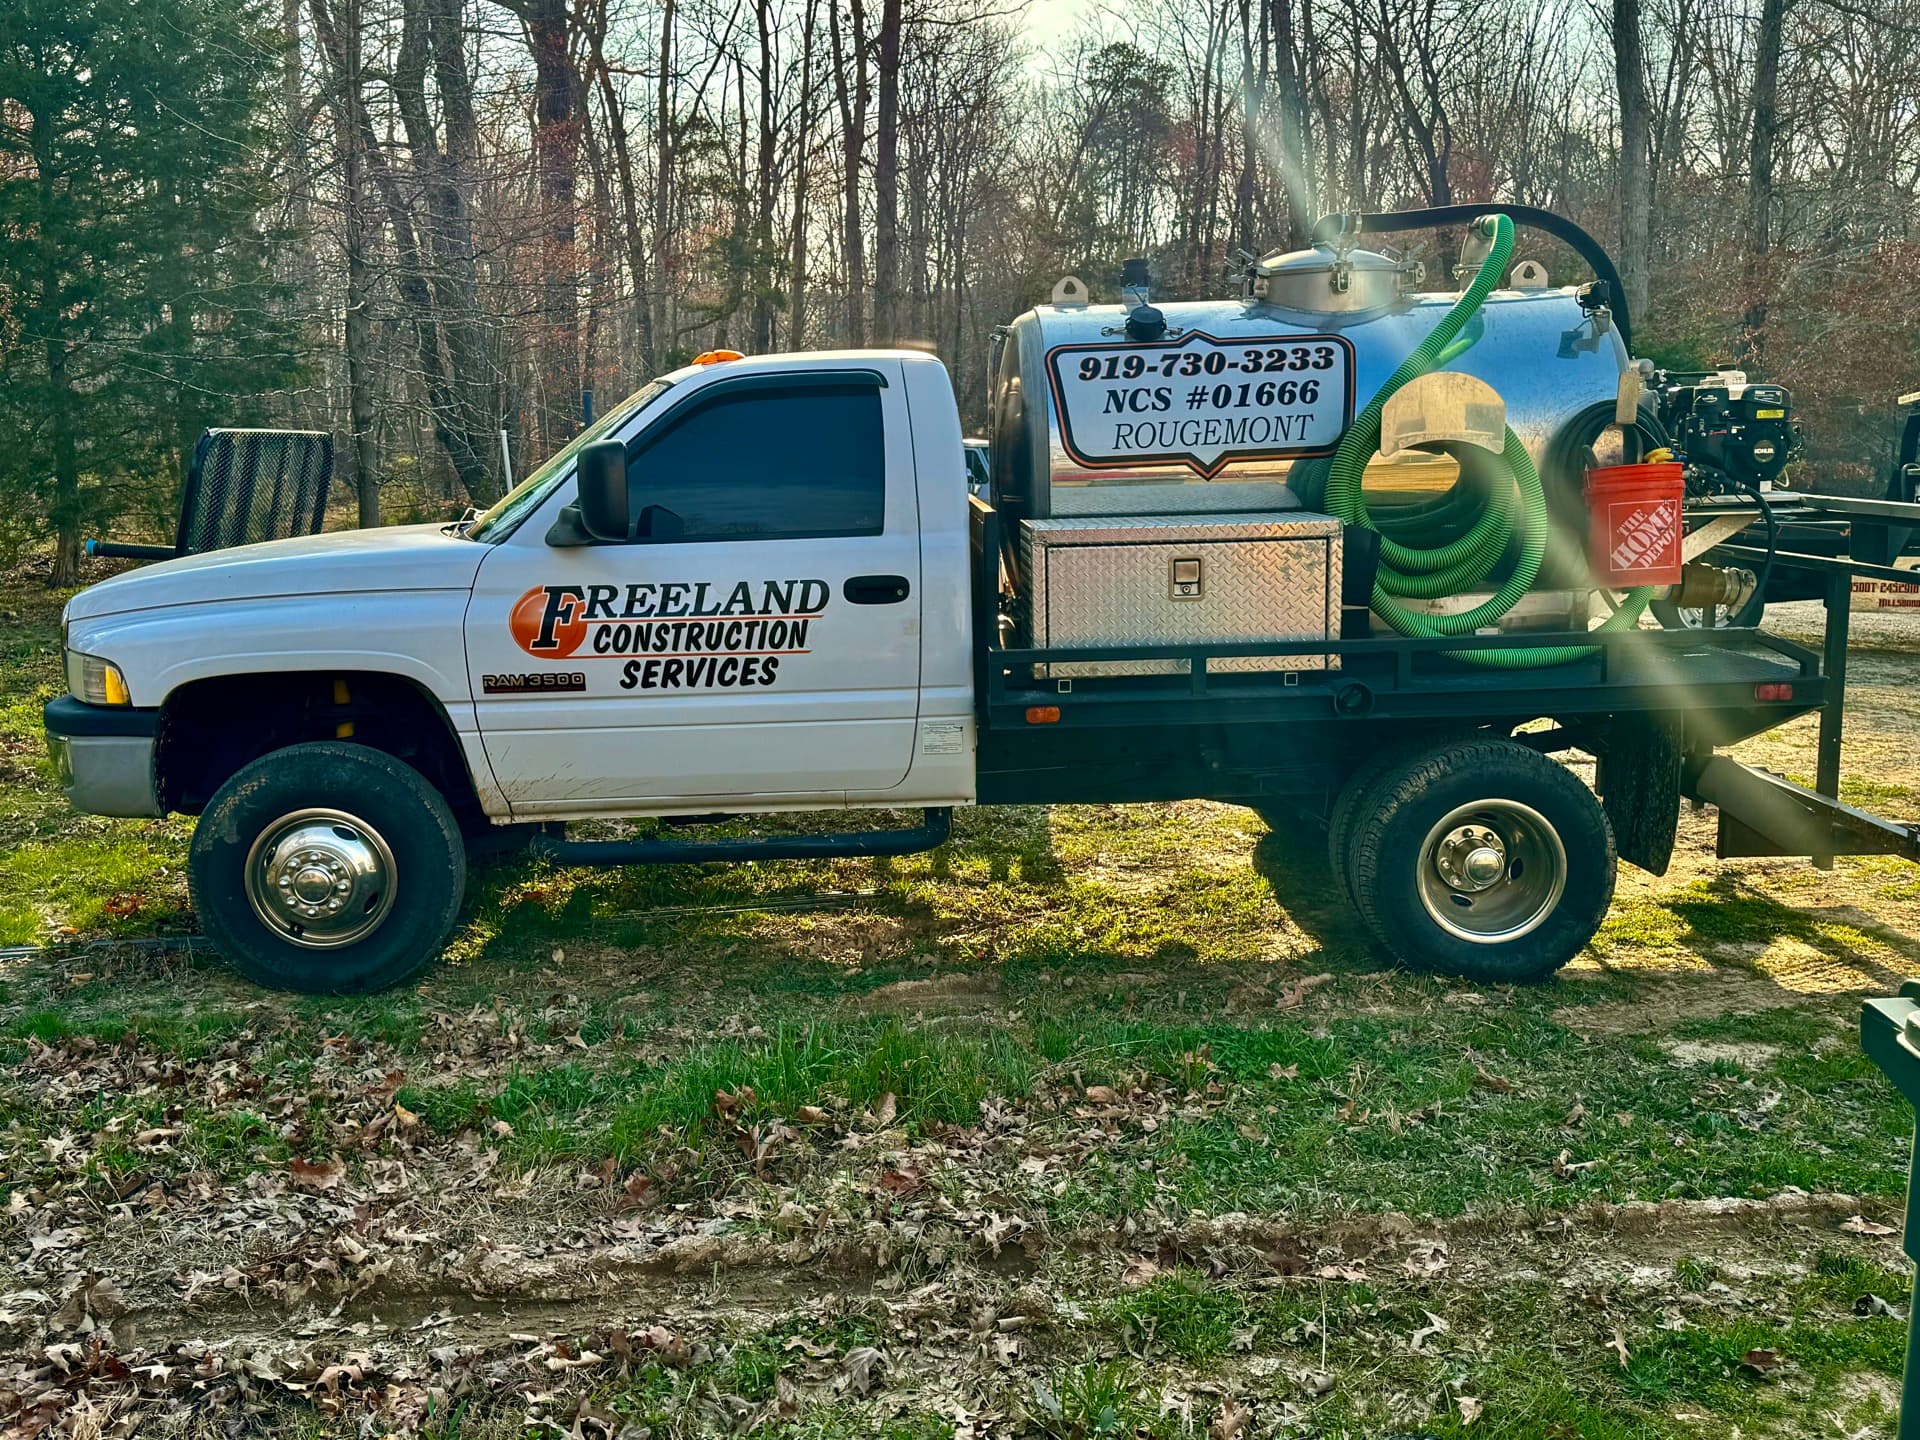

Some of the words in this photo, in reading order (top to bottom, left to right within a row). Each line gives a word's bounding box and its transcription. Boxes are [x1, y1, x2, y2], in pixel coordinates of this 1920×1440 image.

[1078, 346, 1334, 381] 919-730-3233
[1102, 387, 1172, 413] NCS
[1186, 379, 1320, 409] #01666
[1112, 414, 1314, 450] ROUGEMONT
[1612, 504, 1674, 569] HOME
[1616, 509, 1648, 537] THE
[1638, 525, 1676, 568] DEPOT
[530, 579, 830, 649] FREELAND
[593, 619, 808, 653] CONSTRUCTION
[483, 675, 524, 687] RAM
[529, 673, 584, 686] 3500
[619, 656, 779, 689] SERVICES
